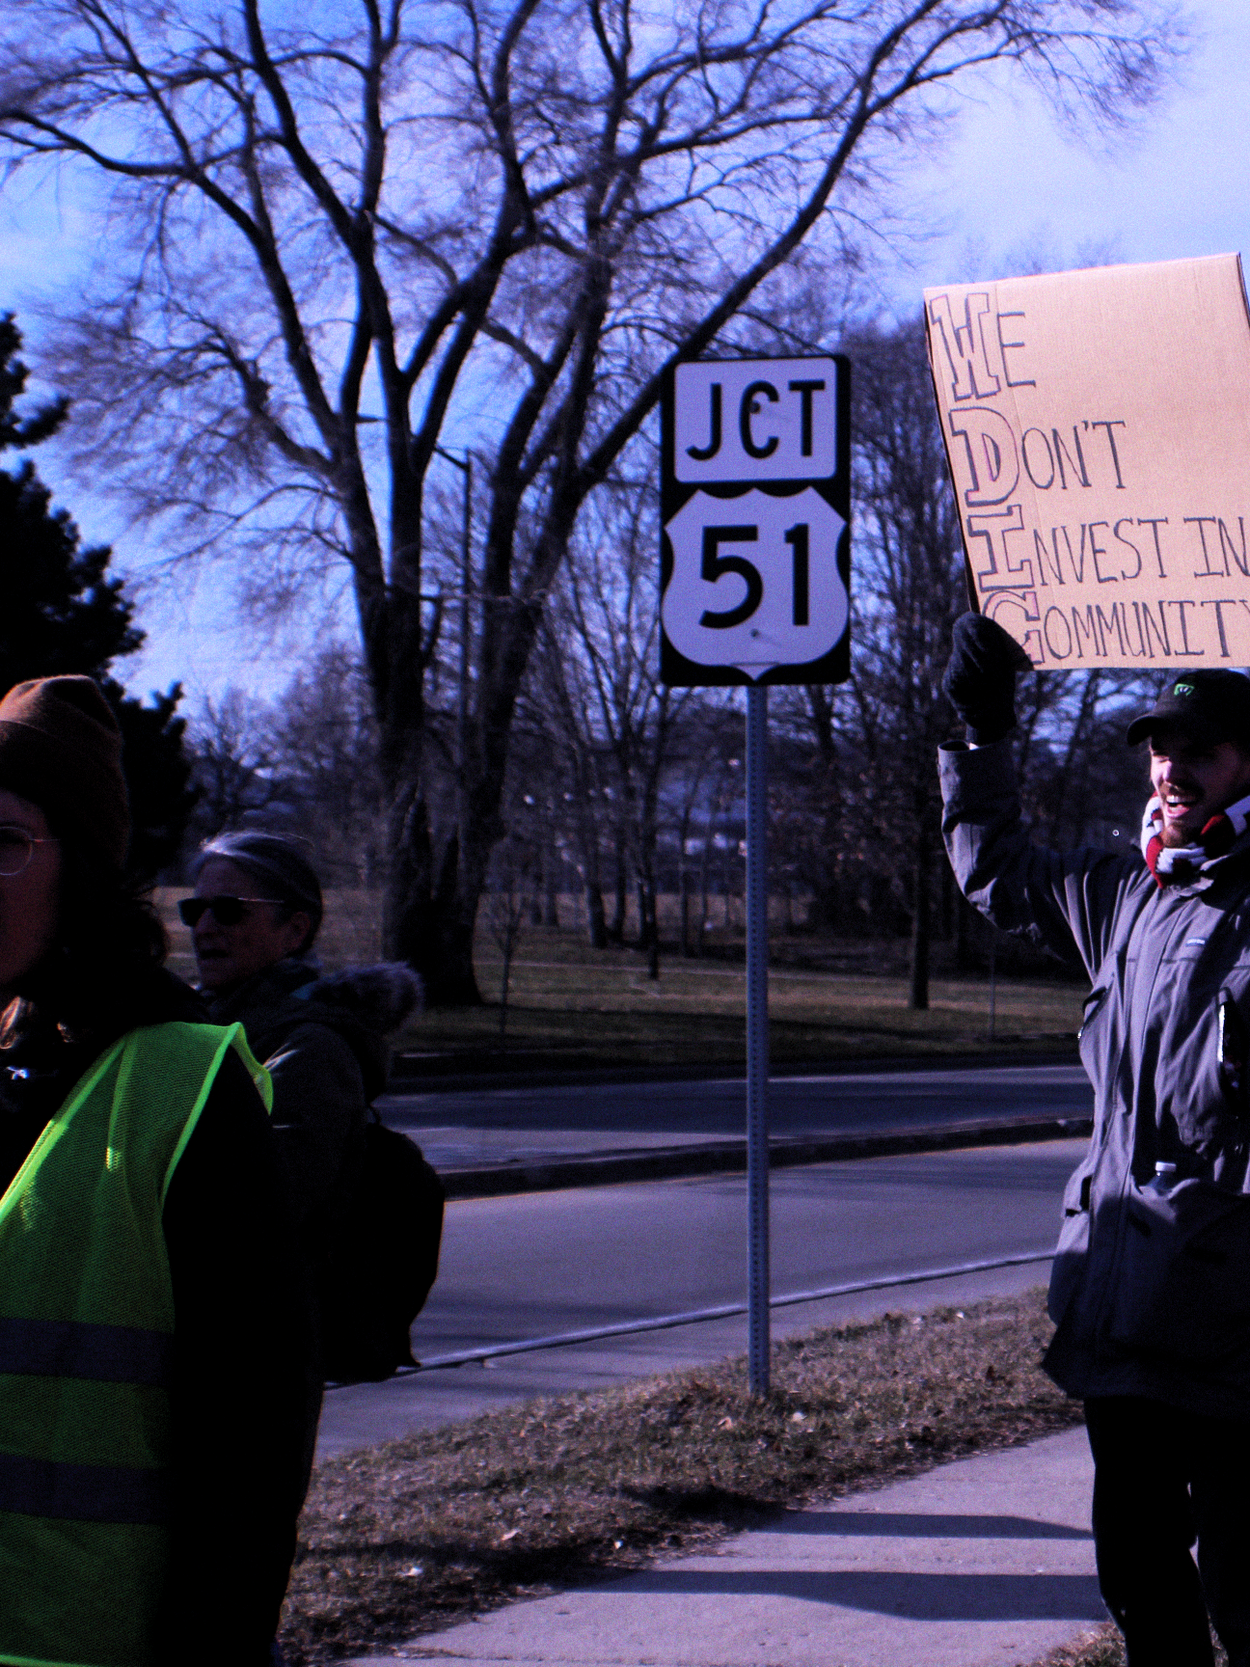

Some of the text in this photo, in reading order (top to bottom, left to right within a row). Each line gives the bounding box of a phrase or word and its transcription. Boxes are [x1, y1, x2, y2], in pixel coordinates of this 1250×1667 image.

[930, 292, 1036, 402] WE
[685, 379, 826, 461] JCT
[948, 406, 1126, 507] DON'T
[698, 523, 810, 629] 51
[967, 504, 1169, 593] INVEST
